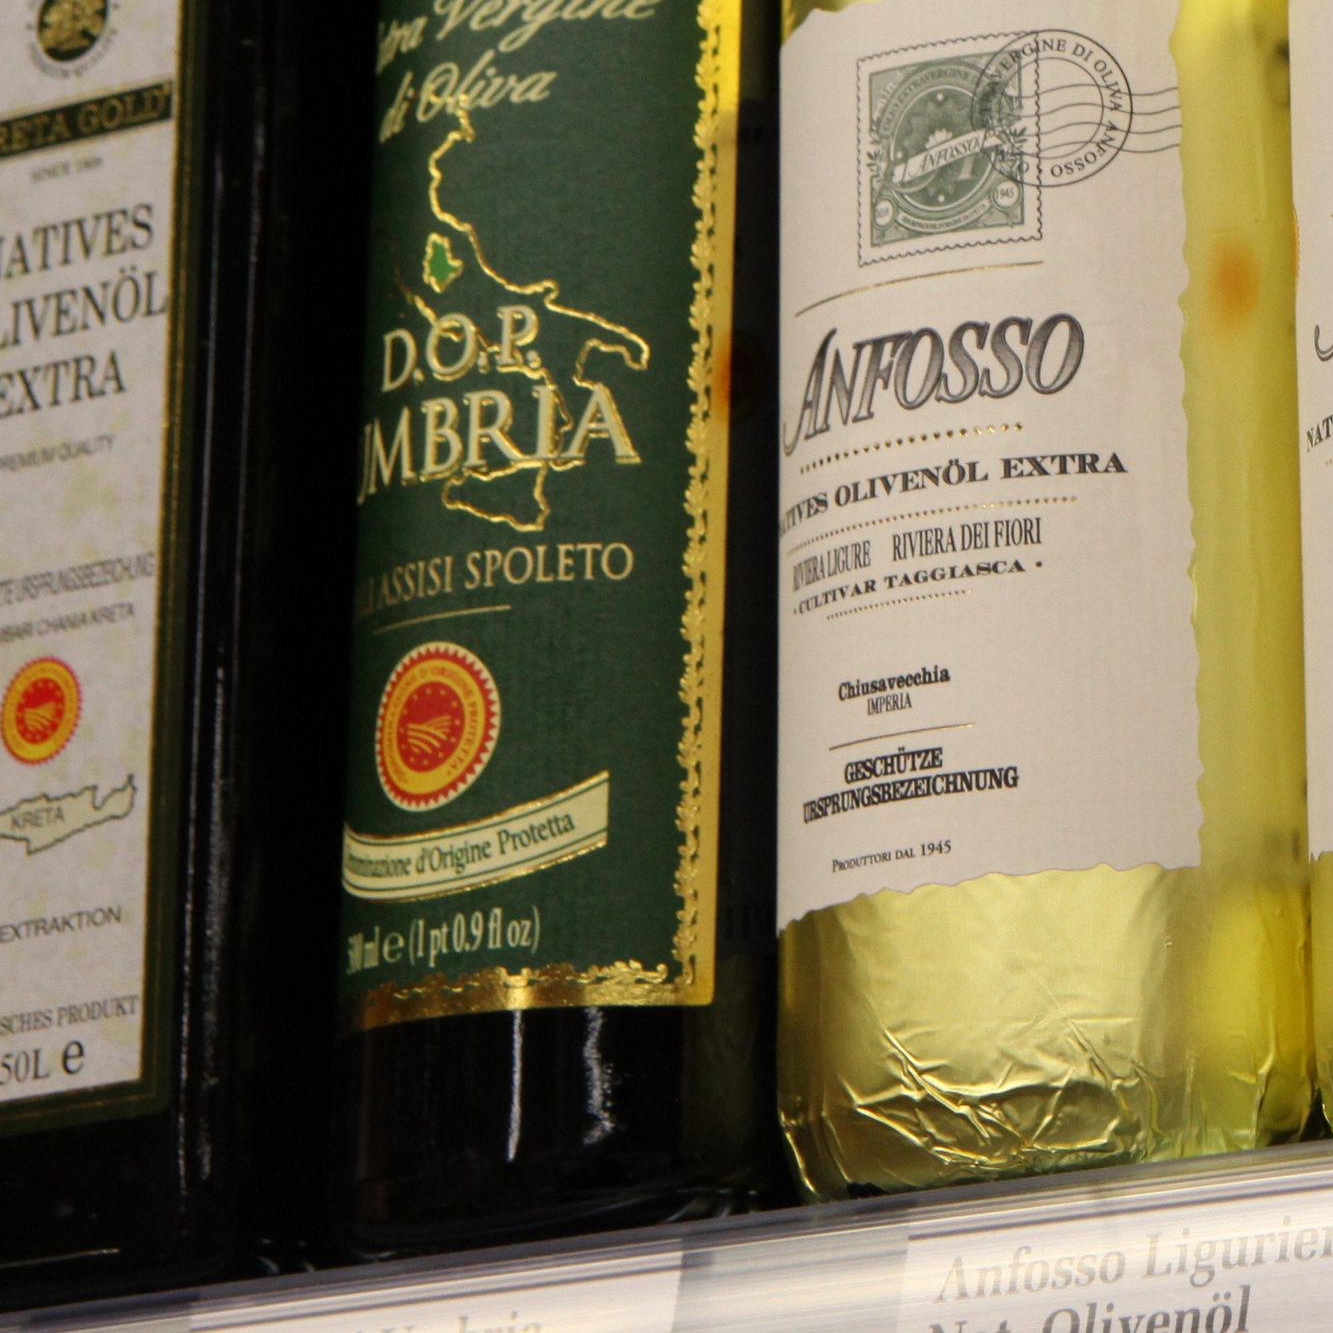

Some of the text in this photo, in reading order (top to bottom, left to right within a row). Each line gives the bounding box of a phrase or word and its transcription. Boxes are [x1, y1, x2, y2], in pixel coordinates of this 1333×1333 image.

[417, 49, 557, 122] Oliva
[382, 304, 542, 392] D.O.P.
[782, 312, 1084, 447] ANFOSSO
[835, 452, 1128, 507] OLIVENÖL EXTRA
[893, 517, 1042, 561] RIVIERA DEI FIORI
[465, 542, 634, 590] SPOLETO
[798, 559, 1026, 615] CULTIVAR TAGGIASCA
[838, 665, 950, 702] Chiusavecchia
[867, 692, 912, 716] IMPERIA
[844, 746, 943, 785] GESCHÜTZE
[803, 767, 1019, 824] URSPRUNGSBEZEICHNUNG
[499, 812, 576, 856] Protetta
[920, 839, 951, 857] 1945
[453, 911, 483, 952] 0.9
[933, 1244, 1126, 1303] Anfosso
